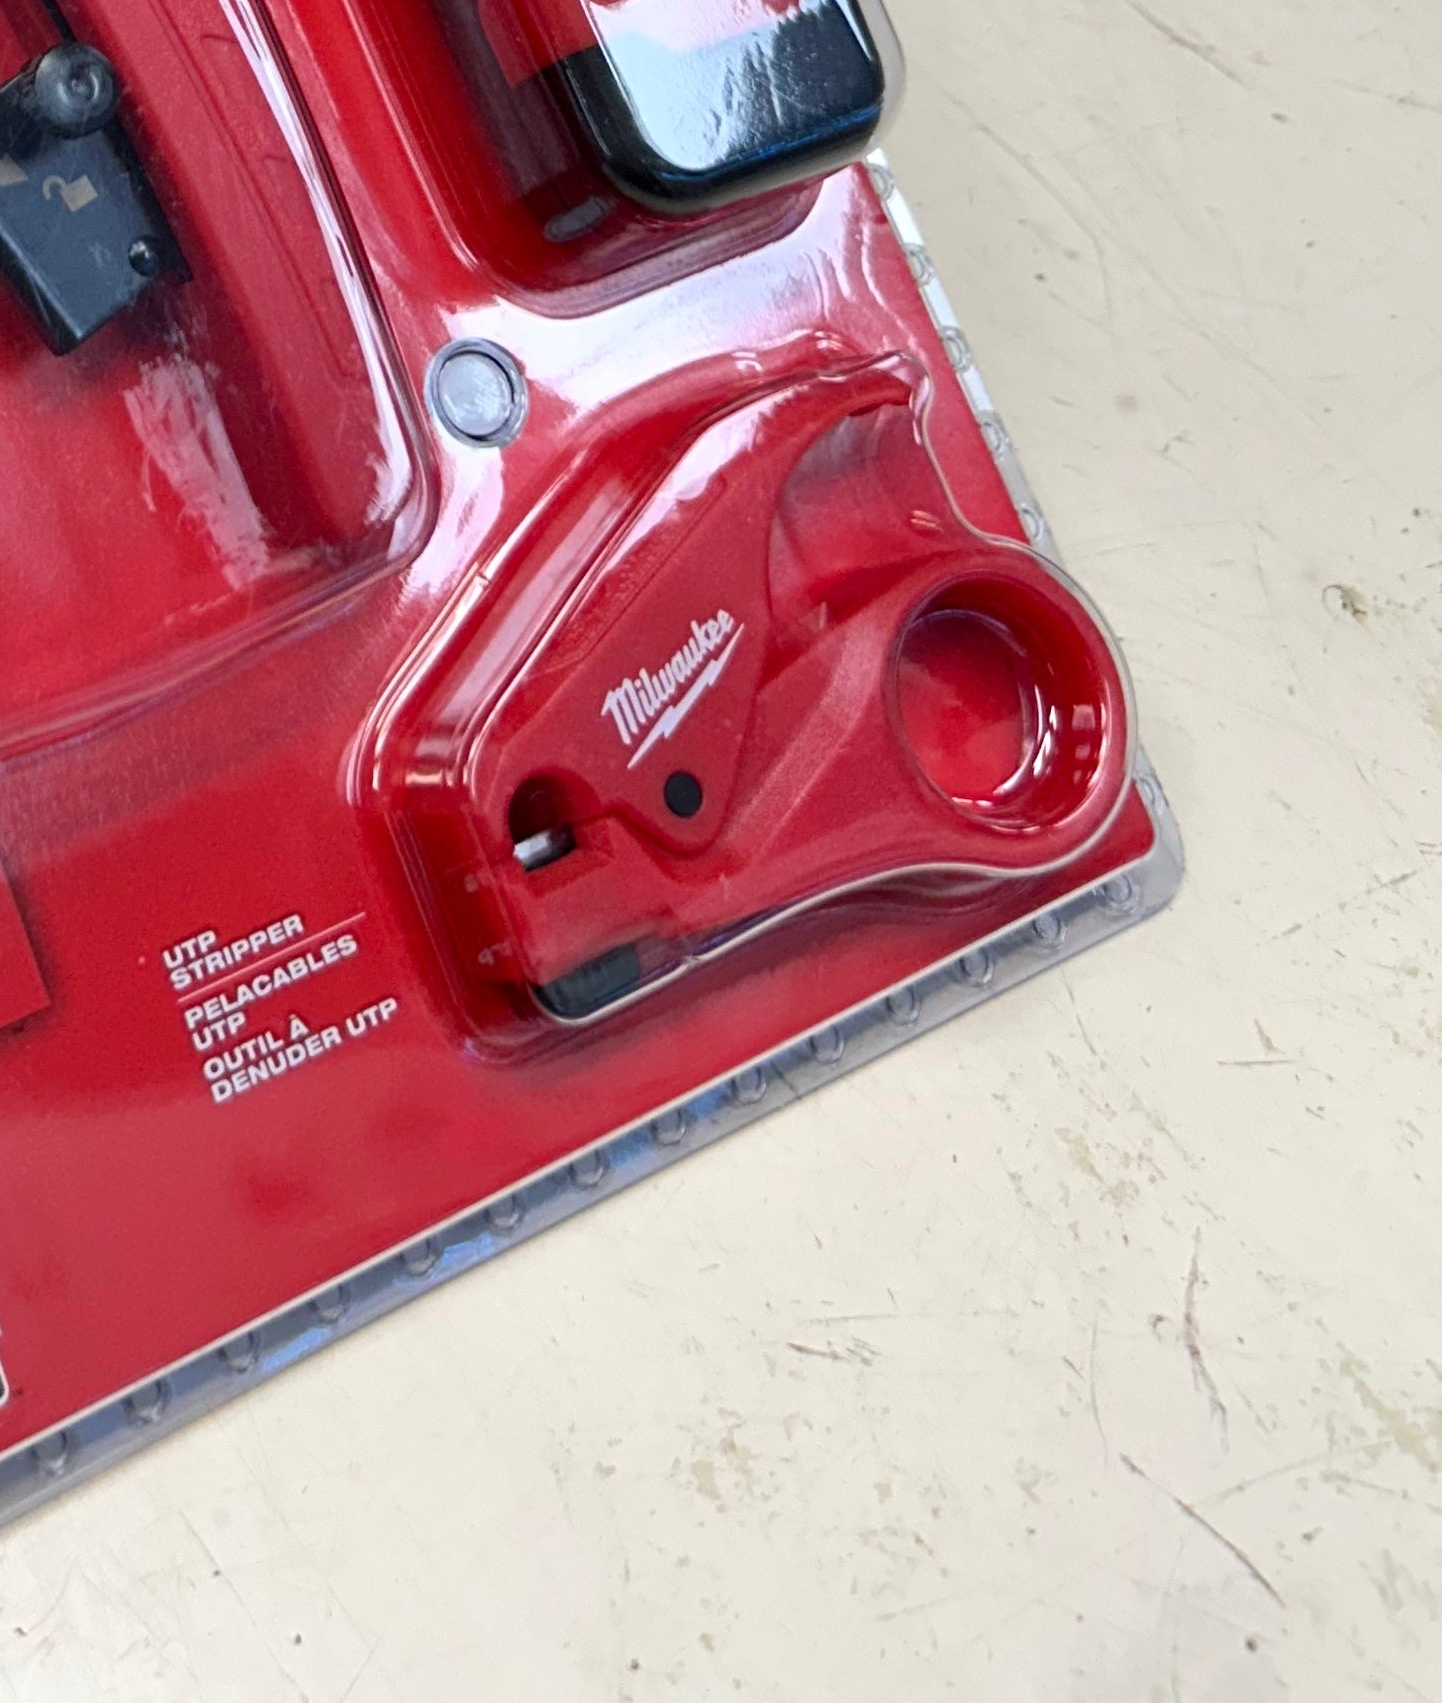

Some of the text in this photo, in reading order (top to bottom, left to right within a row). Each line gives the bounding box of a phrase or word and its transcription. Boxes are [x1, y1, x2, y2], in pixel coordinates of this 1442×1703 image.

[601, 608, 735, 746] Milwaukee
[162, 929, 217, 969] UTP
[169, 913, 304, 991] STRIPPER
[184, 934, 358, 1030] PELACABLES
[191, 1011, 246, 1052] UTP
[202, 1030, 285, 1081] OUTIL
[210, 997, 398, 1104] DENUDER UTP
